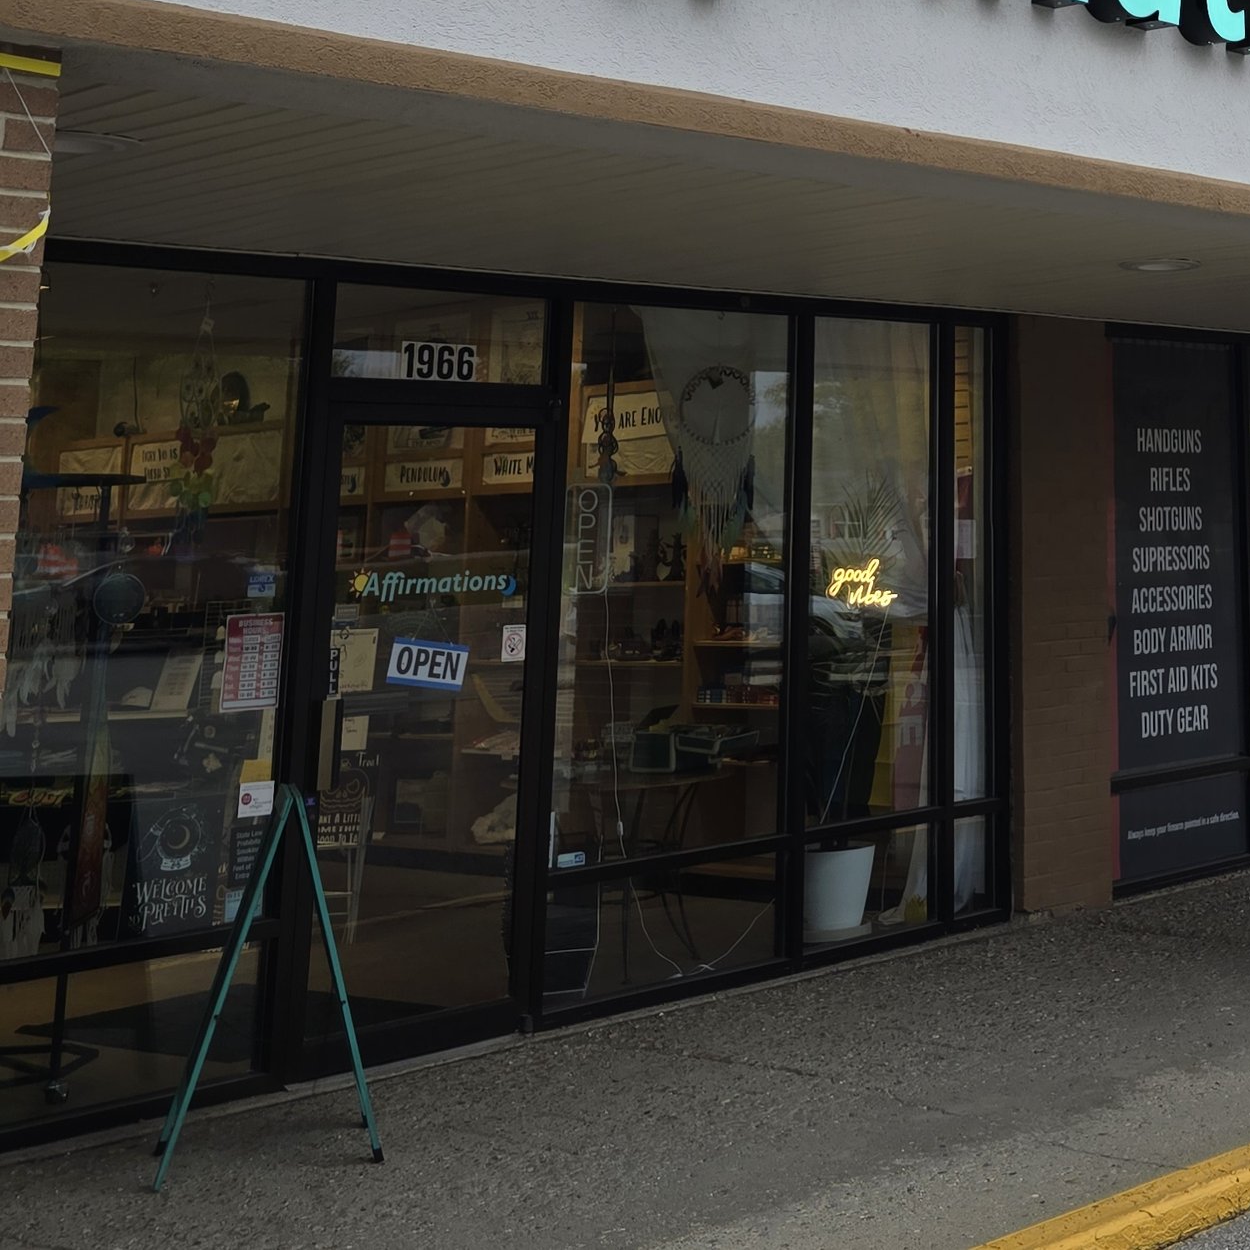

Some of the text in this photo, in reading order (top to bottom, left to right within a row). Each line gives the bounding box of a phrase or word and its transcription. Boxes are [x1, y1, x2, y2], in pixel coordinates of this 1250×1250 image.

[404, 343, 475, 381] 1966
[618, 411, 636, 429] ARE
[640, 407, 663, 425] ENO
[1136, 428, 1202, 454] HANDGUNS
[494, 457, 522, 476] WHITE
[1149, 467, 1191, 492] RIFLES
[1139, 506, 1203, 532] SHOTGUNS
[577, 490, 599, 590] OPEN
[1132, 544, 1210, 573] SUPRESSORS
[362, 570, 508, 603] Affirmations
[829, 558, 880, 597] good
[848, 580, 898, 607] vibes
[1132, 584, 1213, 614] ACCESSORIES
[1133, 623, 1213, 655] BODY ARMOR
[329, 650, 338, 694] PULL
[395, 646, 461, 681] OPEN
[1129, 663, 1218, 698] FIRST AID KITS
[1141, 704, 1209, 739] DUTY GEAR
[136, 875, 208, 906] WELCOME
